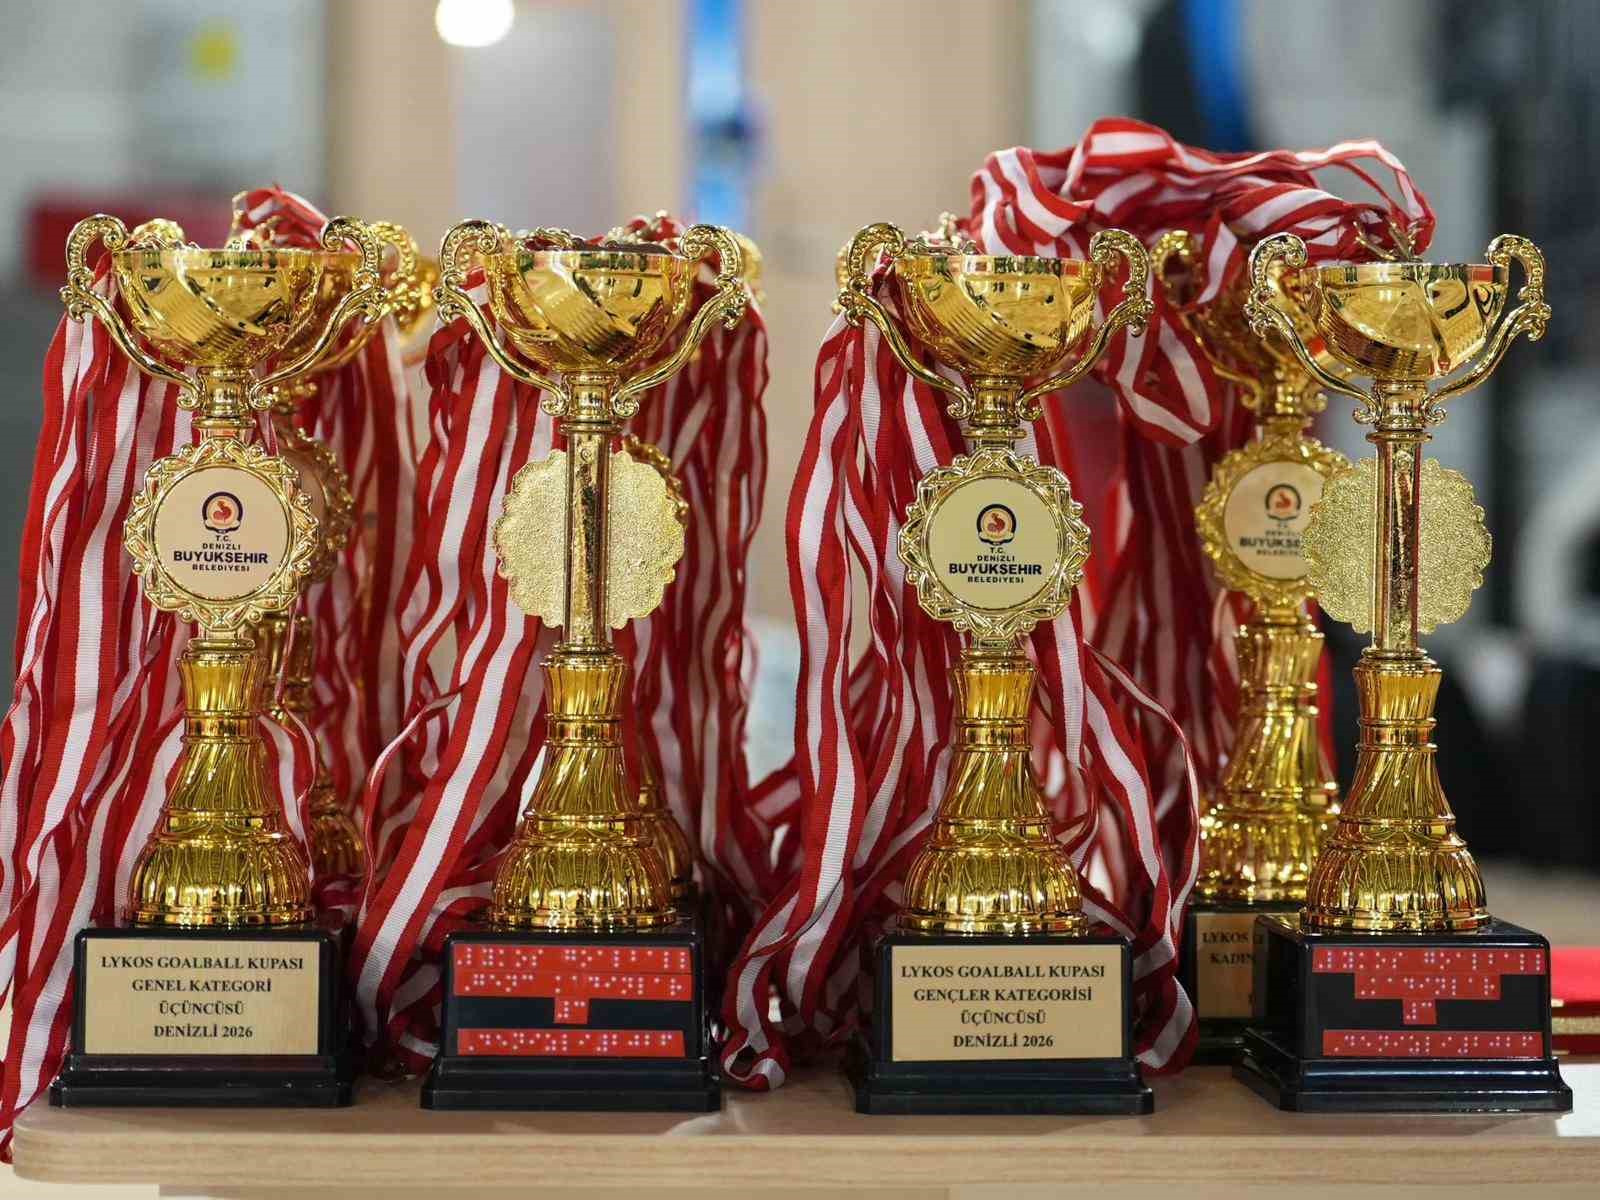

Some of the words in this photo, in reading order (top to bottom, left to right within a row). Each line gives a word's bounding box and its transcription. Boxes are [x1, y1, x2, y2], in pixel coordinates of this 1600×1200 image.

[1203, 932, 1249, 944] LYKOS
[101, 956, 153, 969] LYKOS
[157, 957, 244, 970] GOALBALL
[248, 957, 304, 970] KUPASI
[1210, 953, 1257, 965] KADIN
[901, 965, 954, 978] LYKOS
[957, 965, 1045, 978] GOALBALL
[1049, 965, 1105, 978] KUPASI
[132, 979, 186, 992] GENEL
[190, 978, 272, 993] KATEGORİ
[914, 988, 990, 1004] GENÇLER
[995, 986, 1092, 1002] KATEGORİSİ
[159, 1000, 244, 1017] ÜÇÜNCÜSÜ
[961, 1010, 1046, 1026] ÜÇÜNCÜSÜ
[154, 1024, 218, 1038] DENİZLİ
[222, 1025, 253, 1038] 2026
[953, 1033, 1018, 1048] DENİZLİ
[1023, 1035, 1054, 1048] 2026
